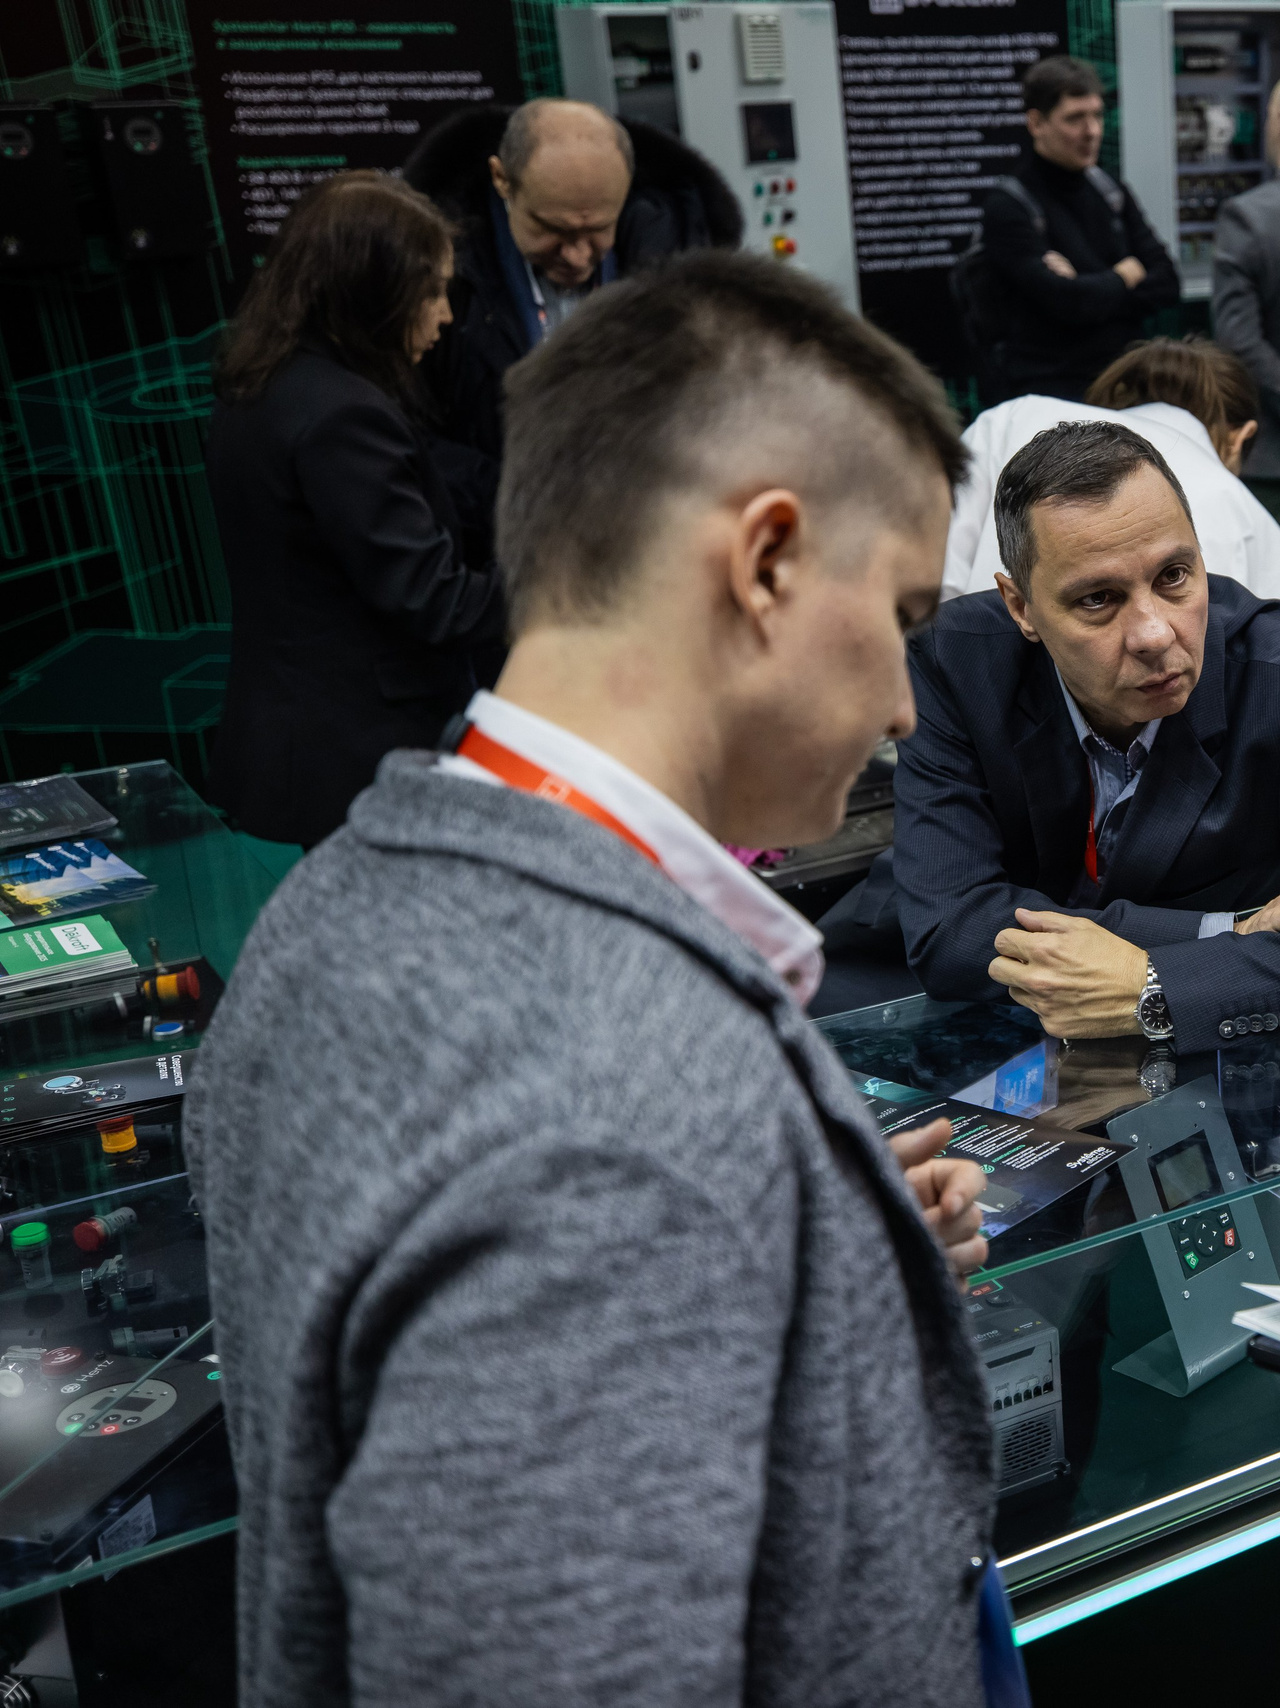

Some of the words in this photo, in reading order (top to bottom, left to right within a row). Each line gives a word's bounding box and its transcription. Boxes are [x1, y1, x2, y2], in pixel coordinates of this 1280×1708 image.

[170, 1054, 184, 1087] Совершенство
[1086, 1148, 1113, 1165] electric
[76, 1359, 115, 1382] Hertz
